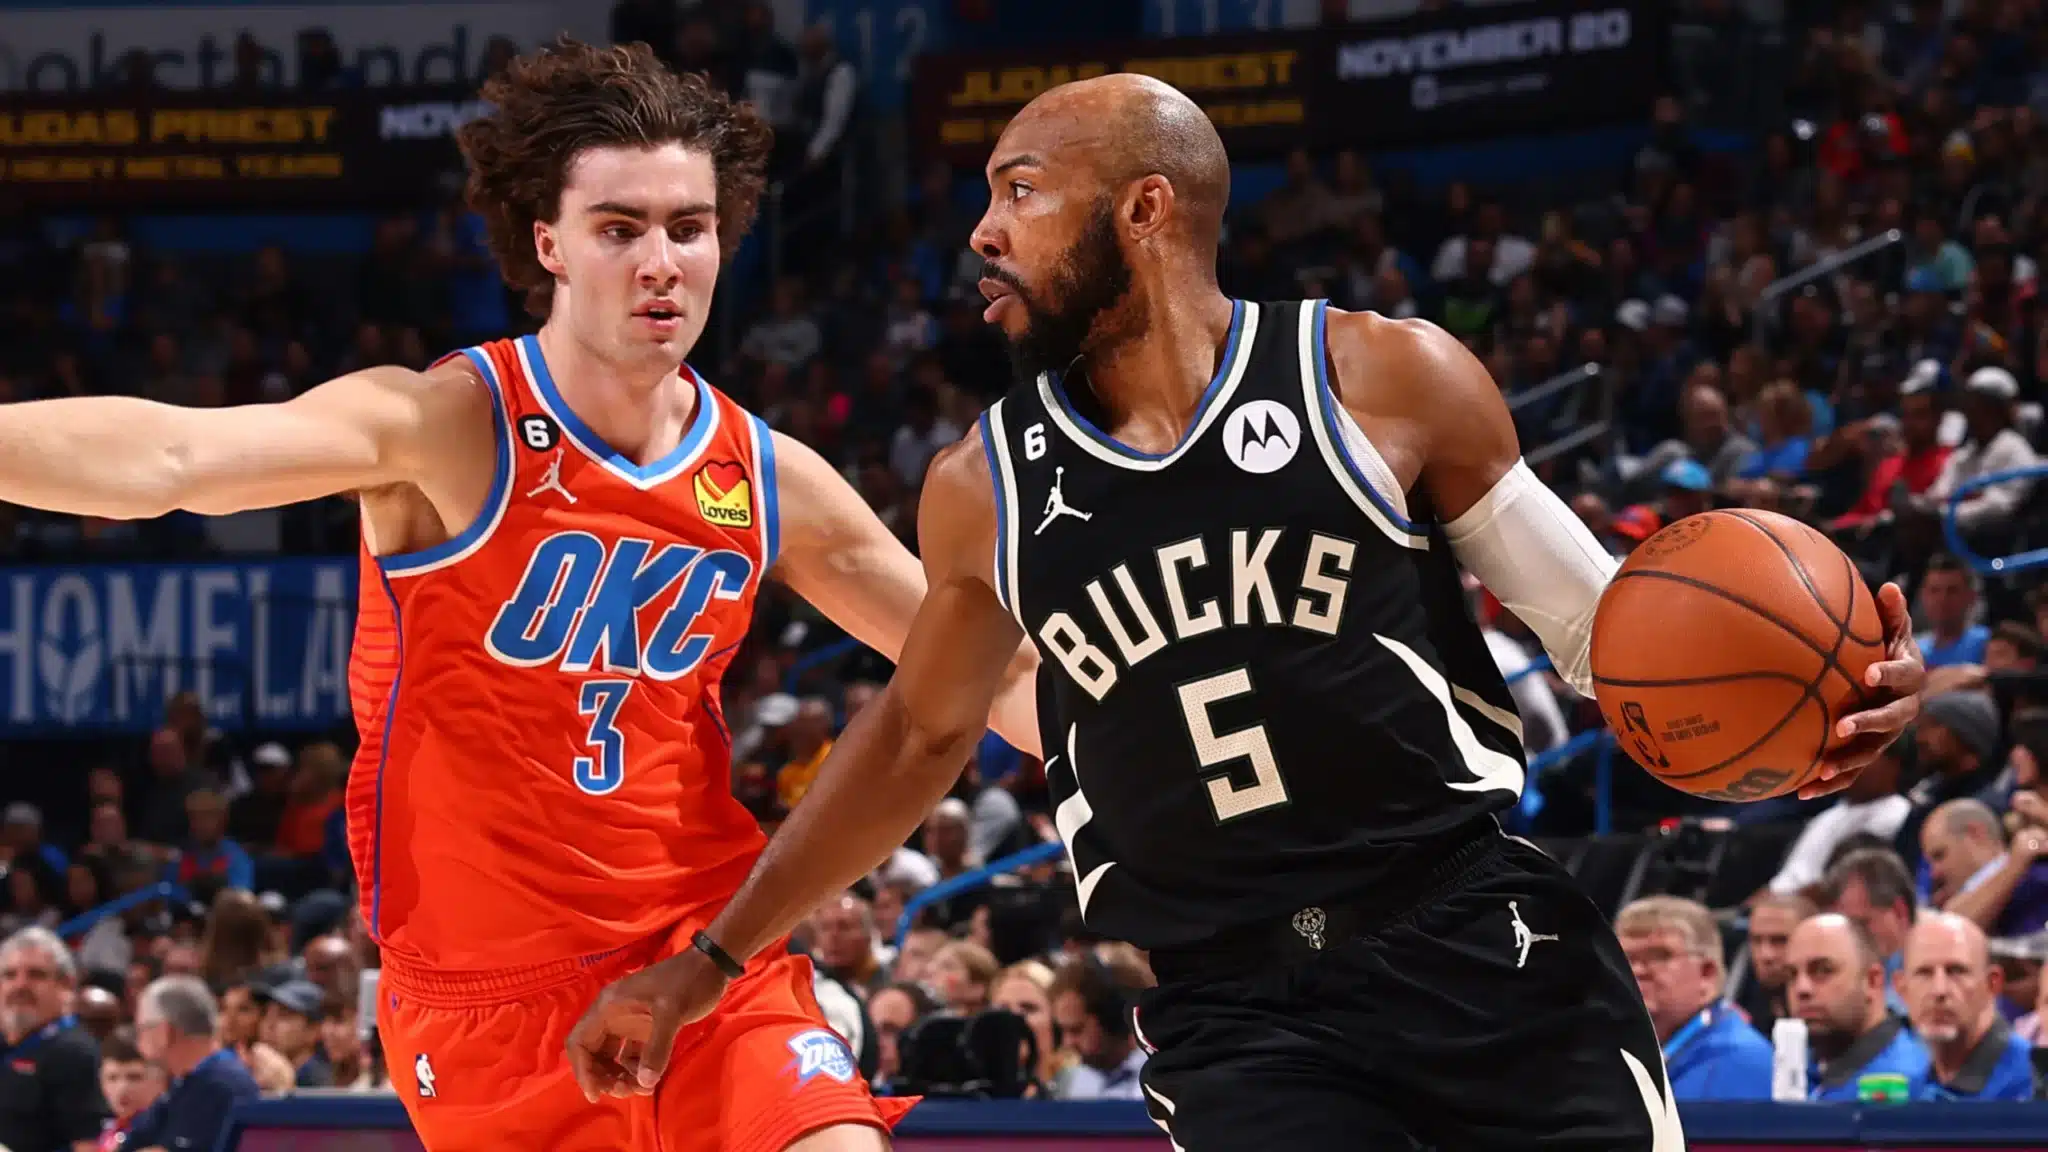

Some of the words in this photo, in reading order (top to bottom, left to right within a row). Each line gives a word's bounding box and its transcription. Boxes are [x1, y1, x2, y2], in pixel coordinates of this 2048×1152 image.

[1336, 16, 1563, 82] NOVEMBER
[1569, 8, 1632, 55] 20
[0, 109, 139, 145] UDAS
[524, 418, 549, 449] 6
[1024, 422, 1047, 461] 6
[484, 530, 753, 681] OKC
[1038, 526, 1359, 703] BUCKS
[573, 680, 633, 795] 3
[1173, 662, 1292, 826] 5
